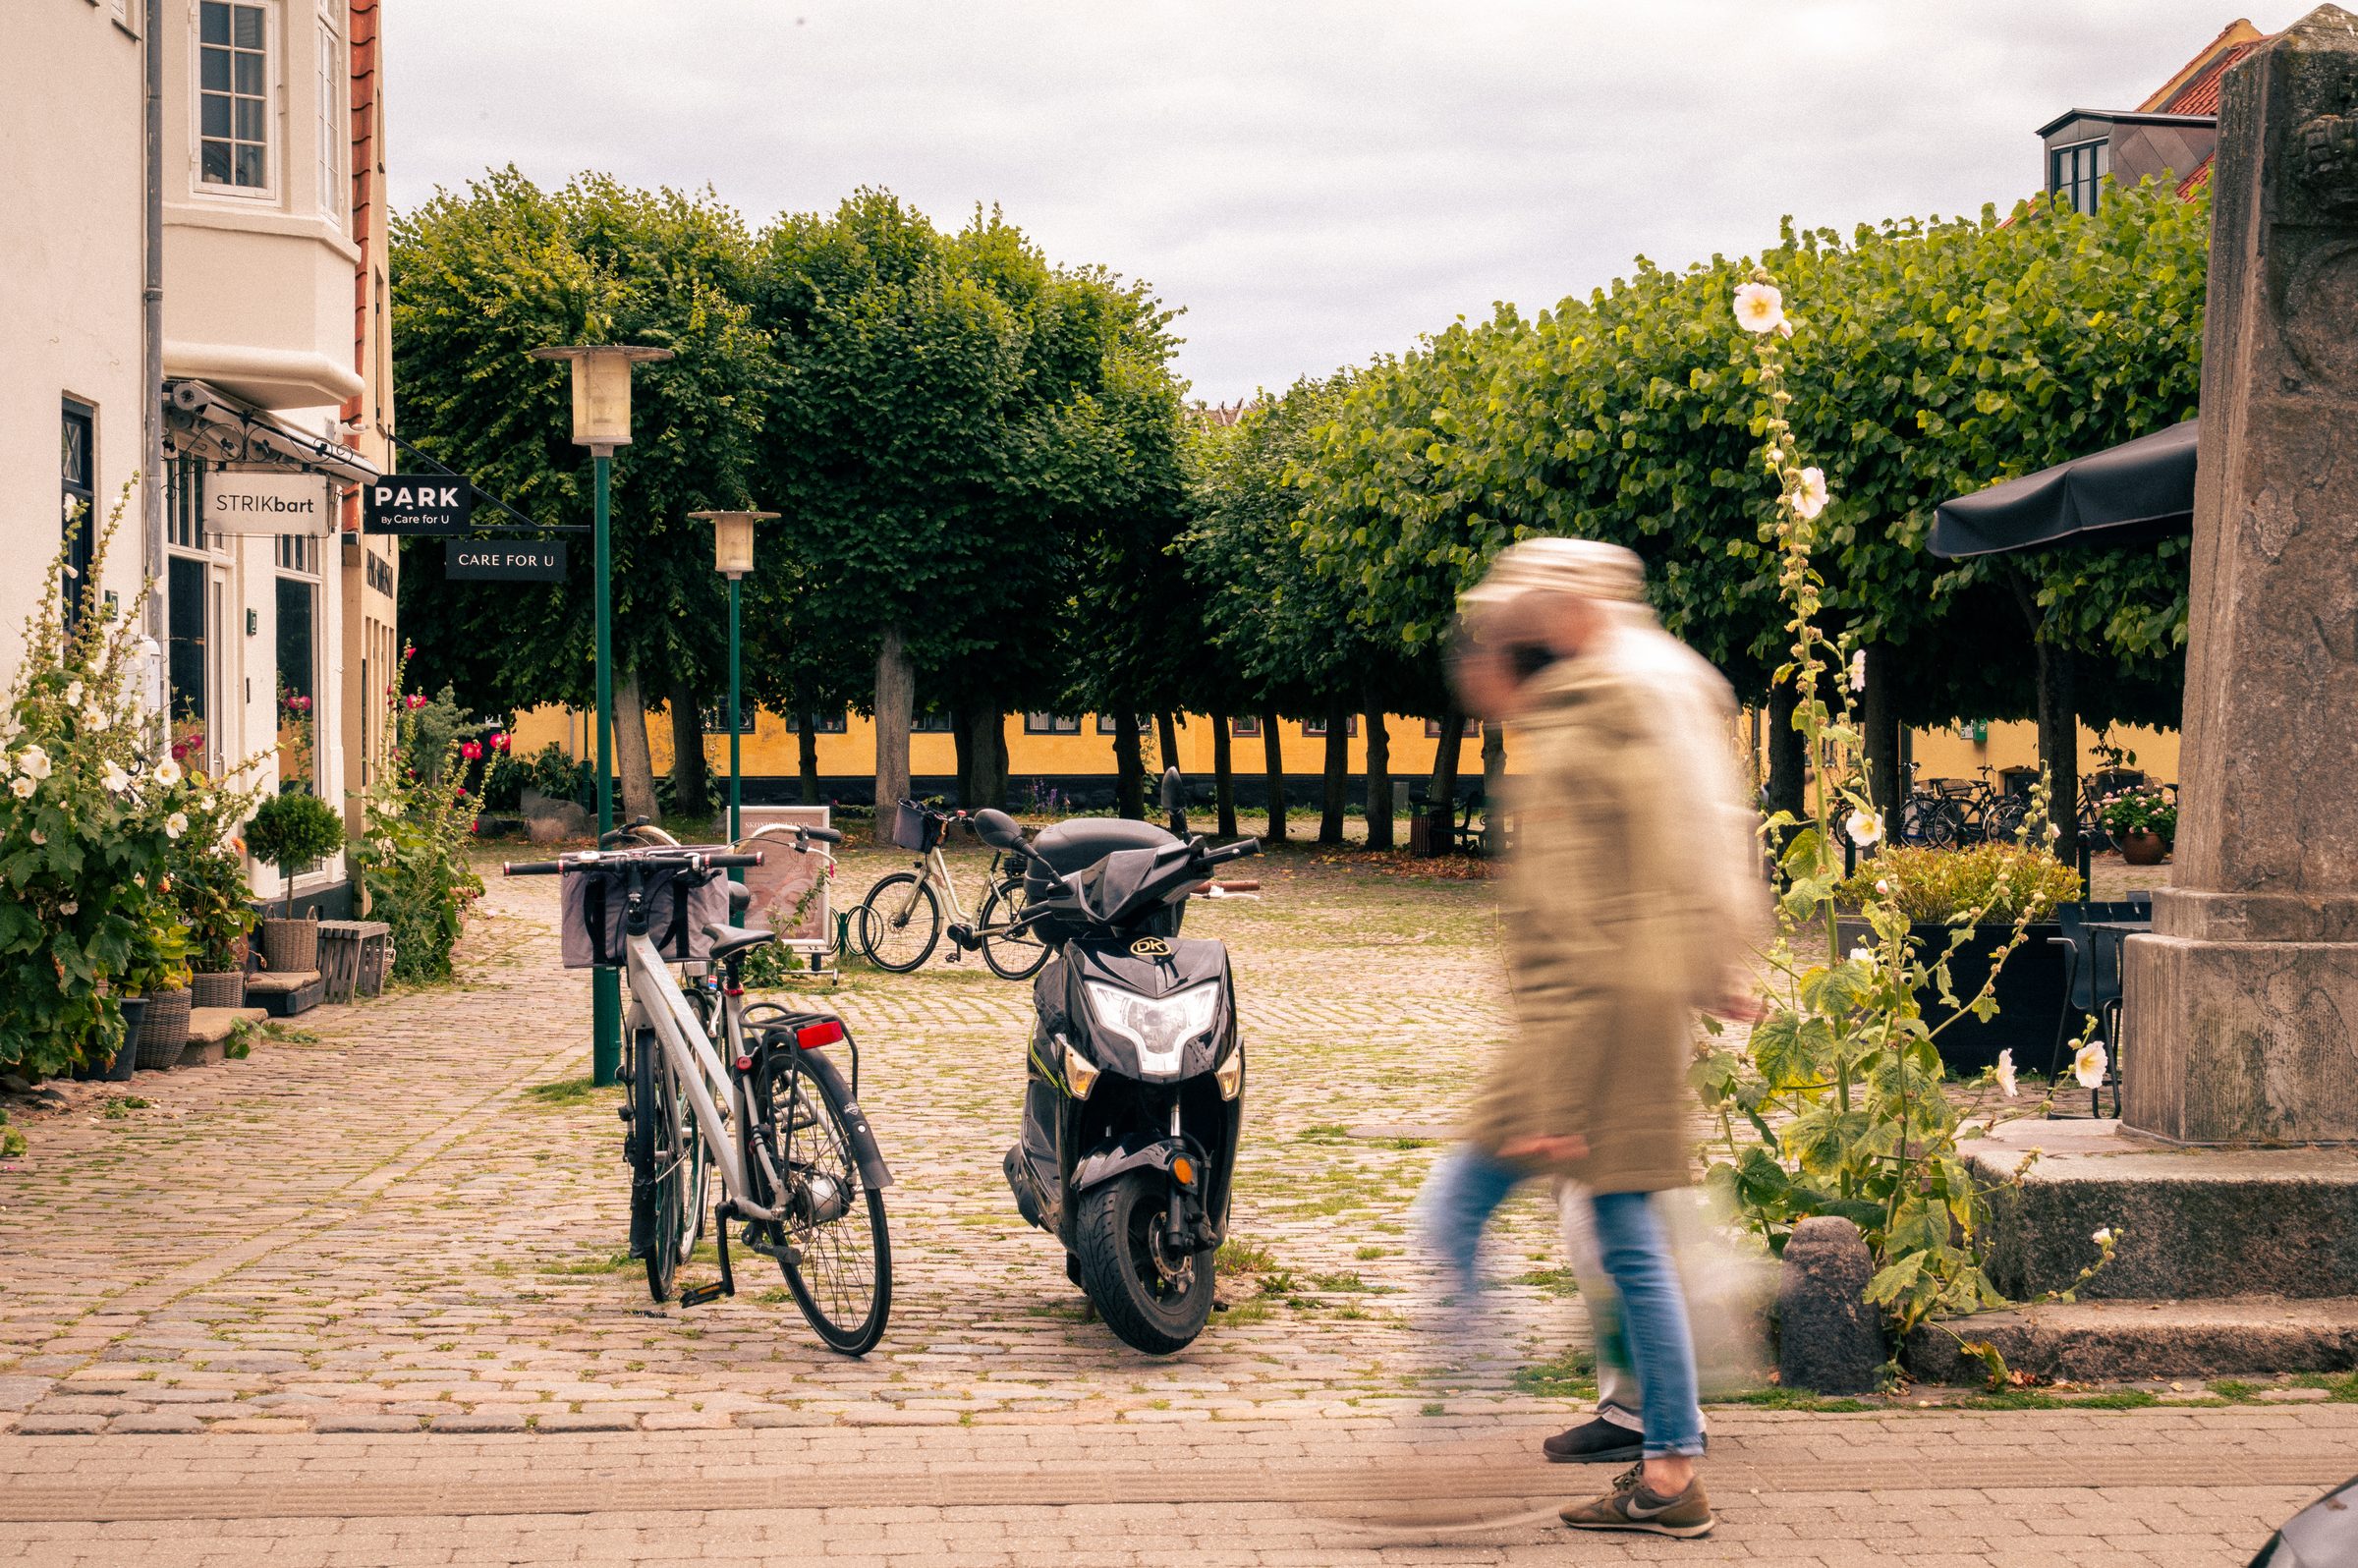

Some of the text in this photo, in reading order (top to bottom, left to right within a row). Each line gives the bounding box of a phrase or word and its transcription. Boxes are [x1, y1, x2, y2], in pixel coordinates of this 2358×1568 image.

[216, 494, 314, 513] STRIKbart
[374, 486, 459, 510] PARK
[381, 514, 450, 525] By Care for U
[458, 553, 554, 567] CARE FOR U
[1137, 940, 1164, 952] DK
